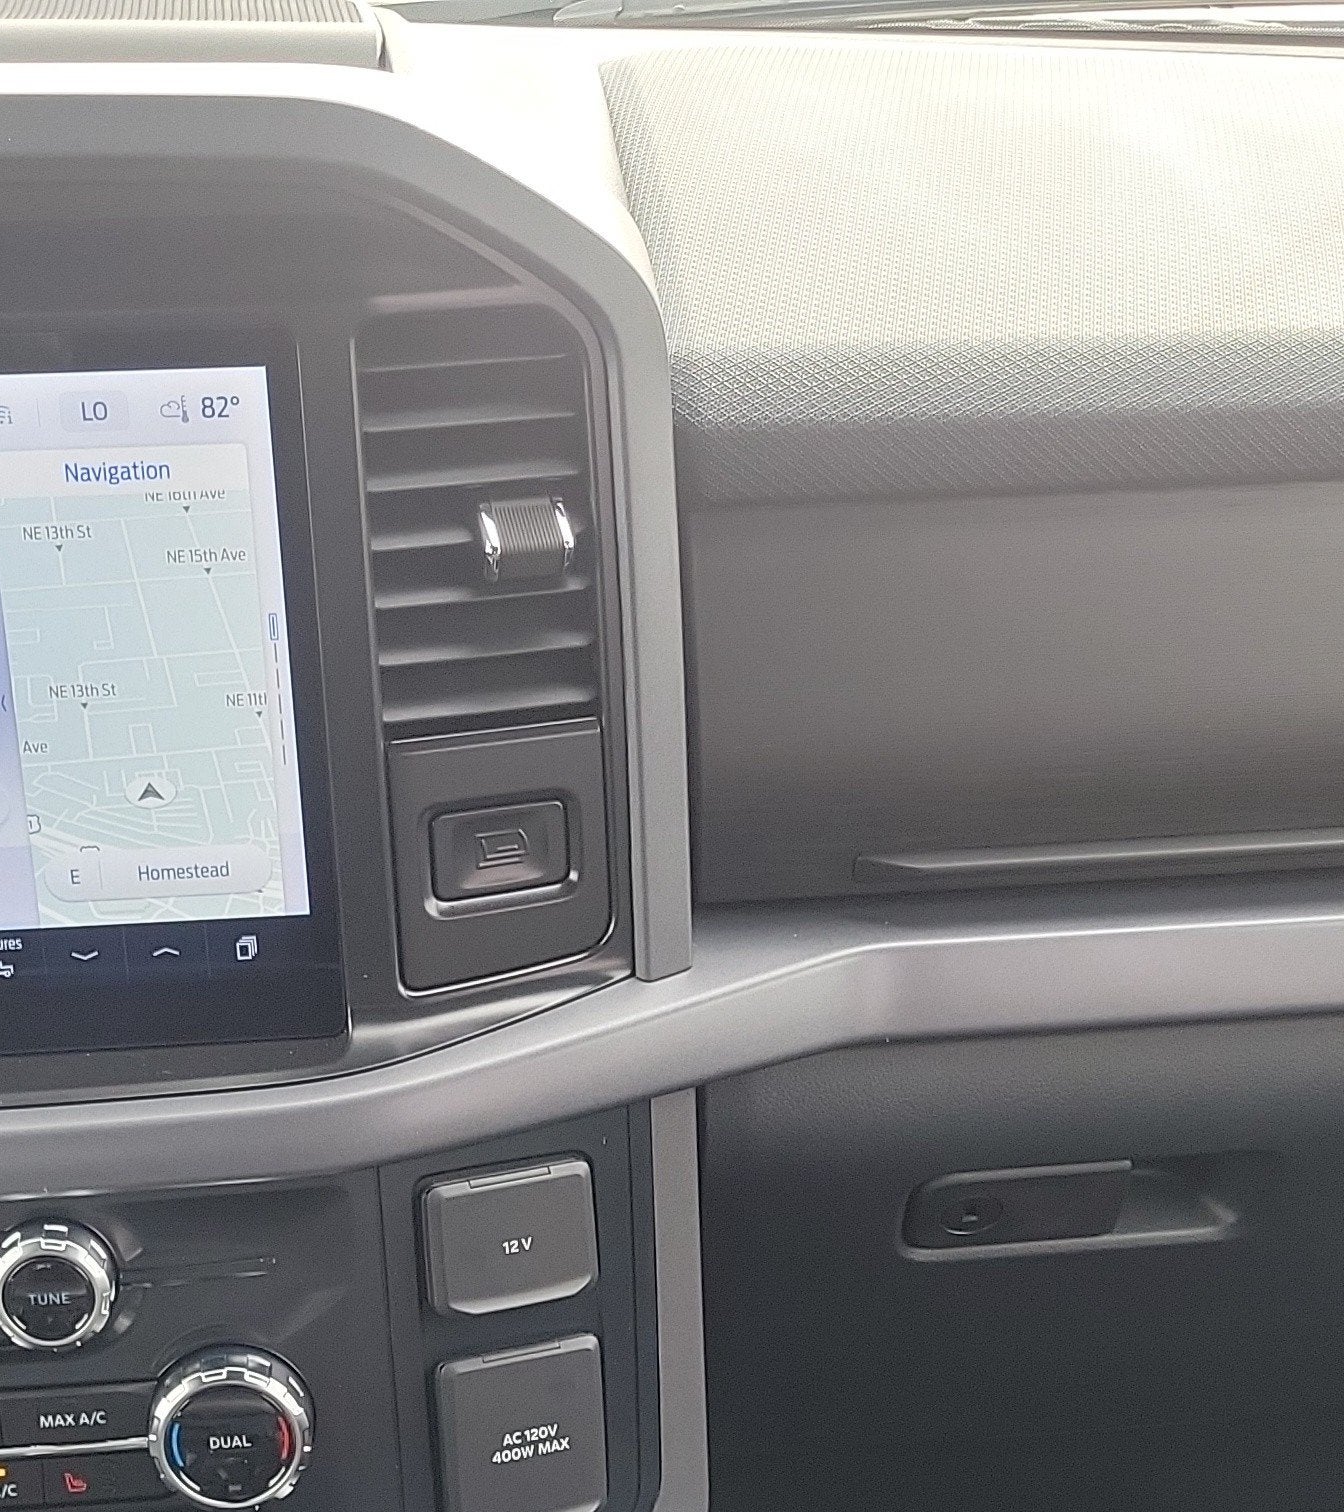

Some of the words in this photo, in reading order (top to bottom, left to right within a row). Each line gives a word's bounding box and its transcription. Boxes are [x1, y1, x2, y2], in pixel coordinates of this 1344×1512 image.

[81, 400, 108, 422] LO
[200, 395, 240, 420] 82°
[64, 460, 171, 485] Navigation
[22, 526, 42, 541] NE
[45, 524, 74, 540] 13th
[77, 524, 92, 539] St
[167, 549, 186, 564] NE
[189, 548, 218, 562] 15th
[221, 548, 246, 562] Ave
[49, 685, 68, 699] NE
[71, 684, 100, 698] 13th
[102, 684, 116, 697] St
[226, 693, 244, 707] NE
[23, 740, 48, 754] Ave
[70, 870, 80, 885] E
[138, 861, 230, 882] Homestead
[502, 1239, 520, 1255] 12
[520, 1236, 533, 1251] V
[29, 1293, 71, 1306] TUNE
[40, 1413, 75, 1429] MAX
[78, 1410, 107, 1426] A/C
[209, 1435, 253, 1451] DUAL
[502, 1430, 522, 1447] AC
[524, 1424, 559, 1443] 120V
[491, 1446, 535, 1465] 400W
[538, 1437, 570, 1456] MAX
